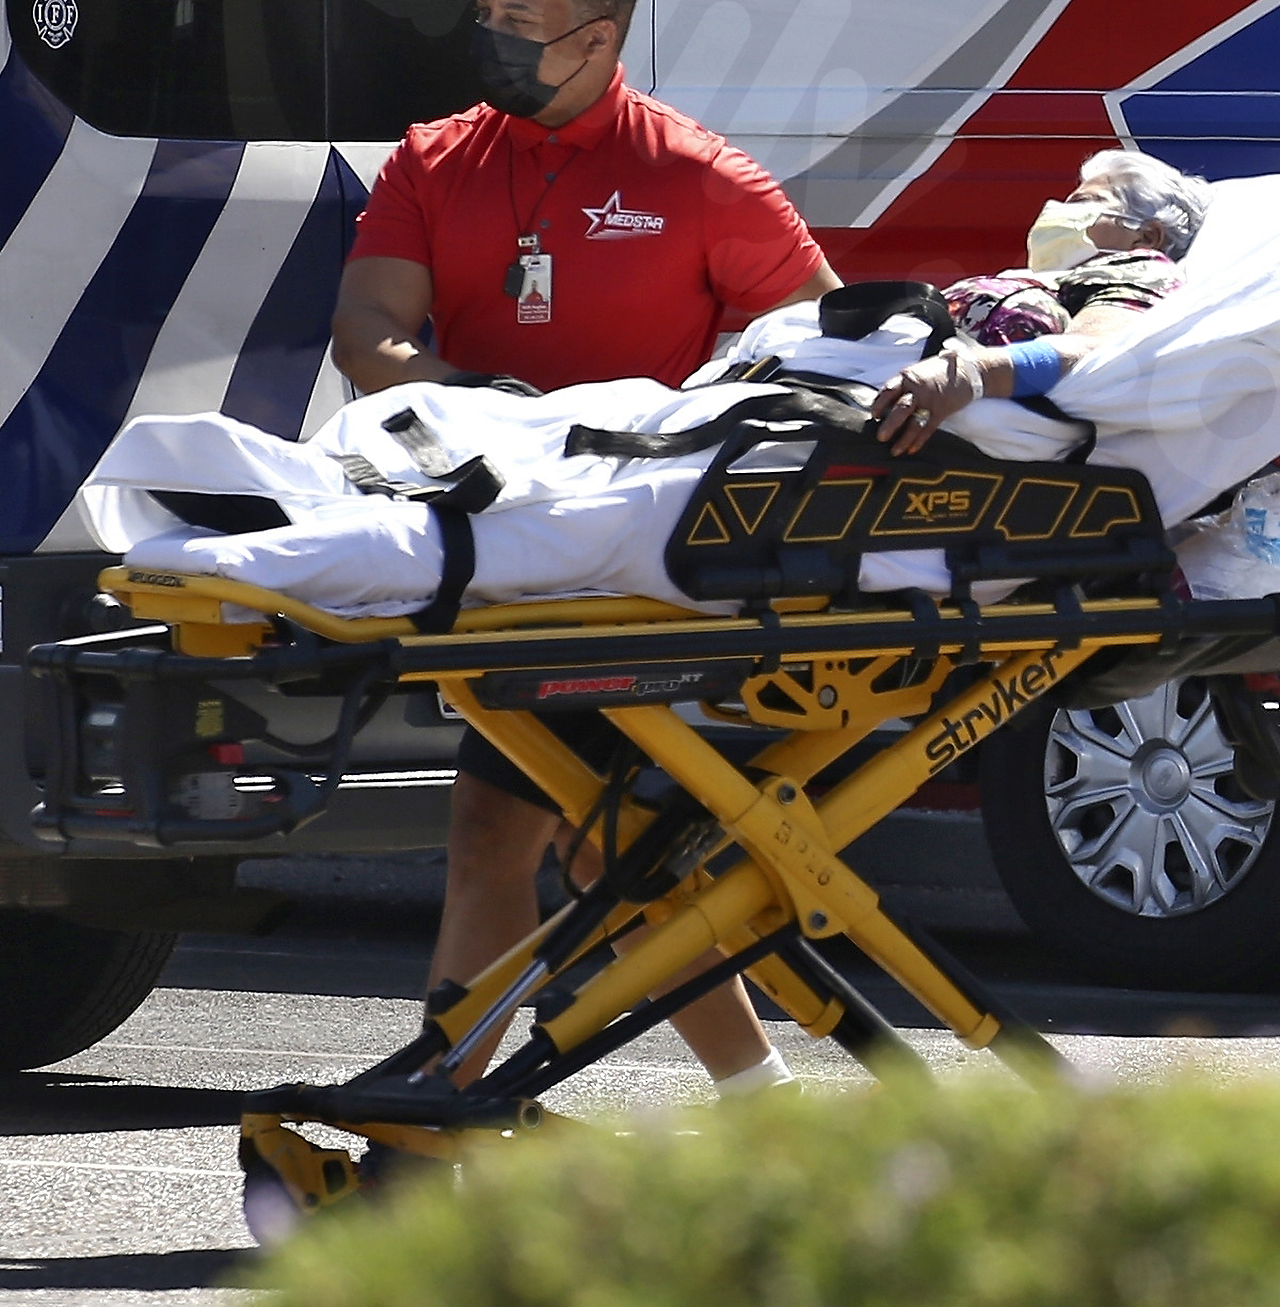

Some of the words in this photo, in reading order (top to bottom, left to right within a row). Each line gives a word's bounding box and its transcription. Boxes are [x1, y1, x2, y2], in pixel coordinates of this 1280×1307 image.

[604, 213, 664, 230] MEDSTAR
[905, 490, 971, 522] XPS
[925, 649, 1064, 774] stryker
